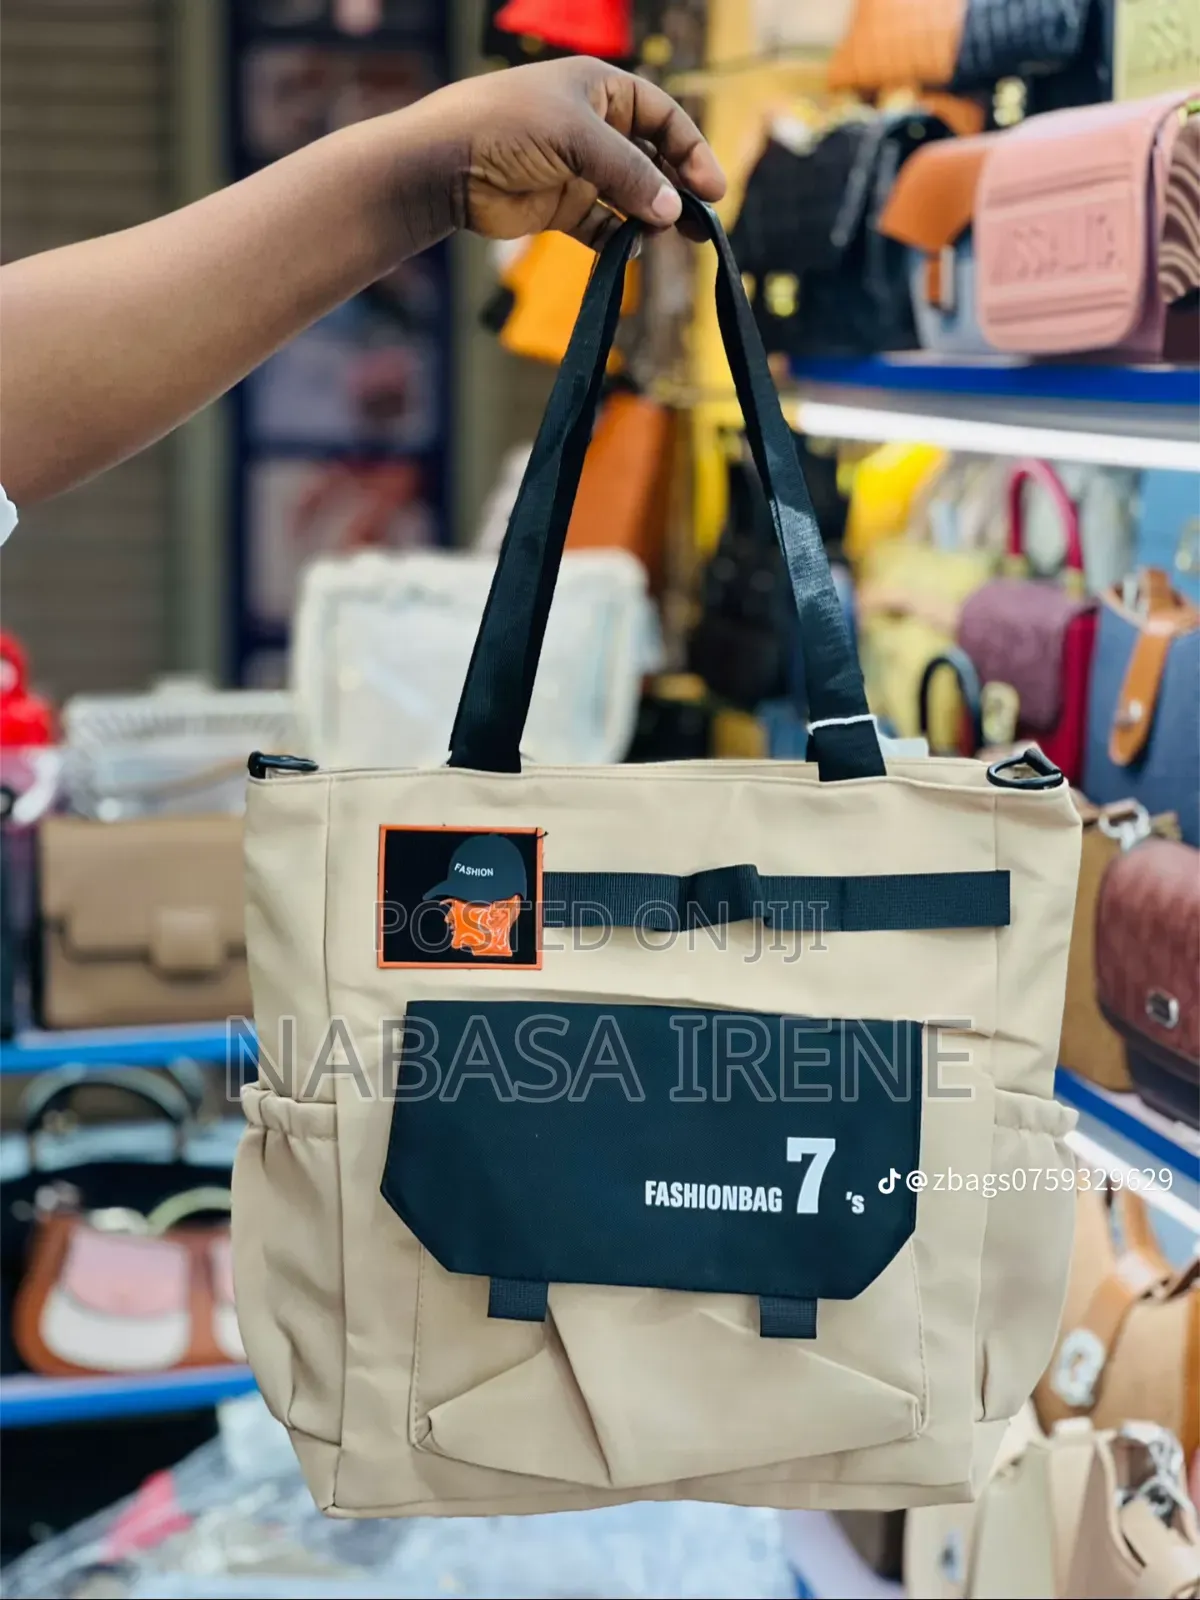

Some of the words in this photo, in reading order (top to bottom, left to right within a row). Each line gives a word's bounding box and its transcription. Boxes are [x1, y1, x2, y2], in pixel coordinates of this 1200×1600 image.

[454, 862, 494, 877] FASHION
[645, 1180, 783, 1213] FASHIONBAG
[786, 1136, 836, 1214] 7
